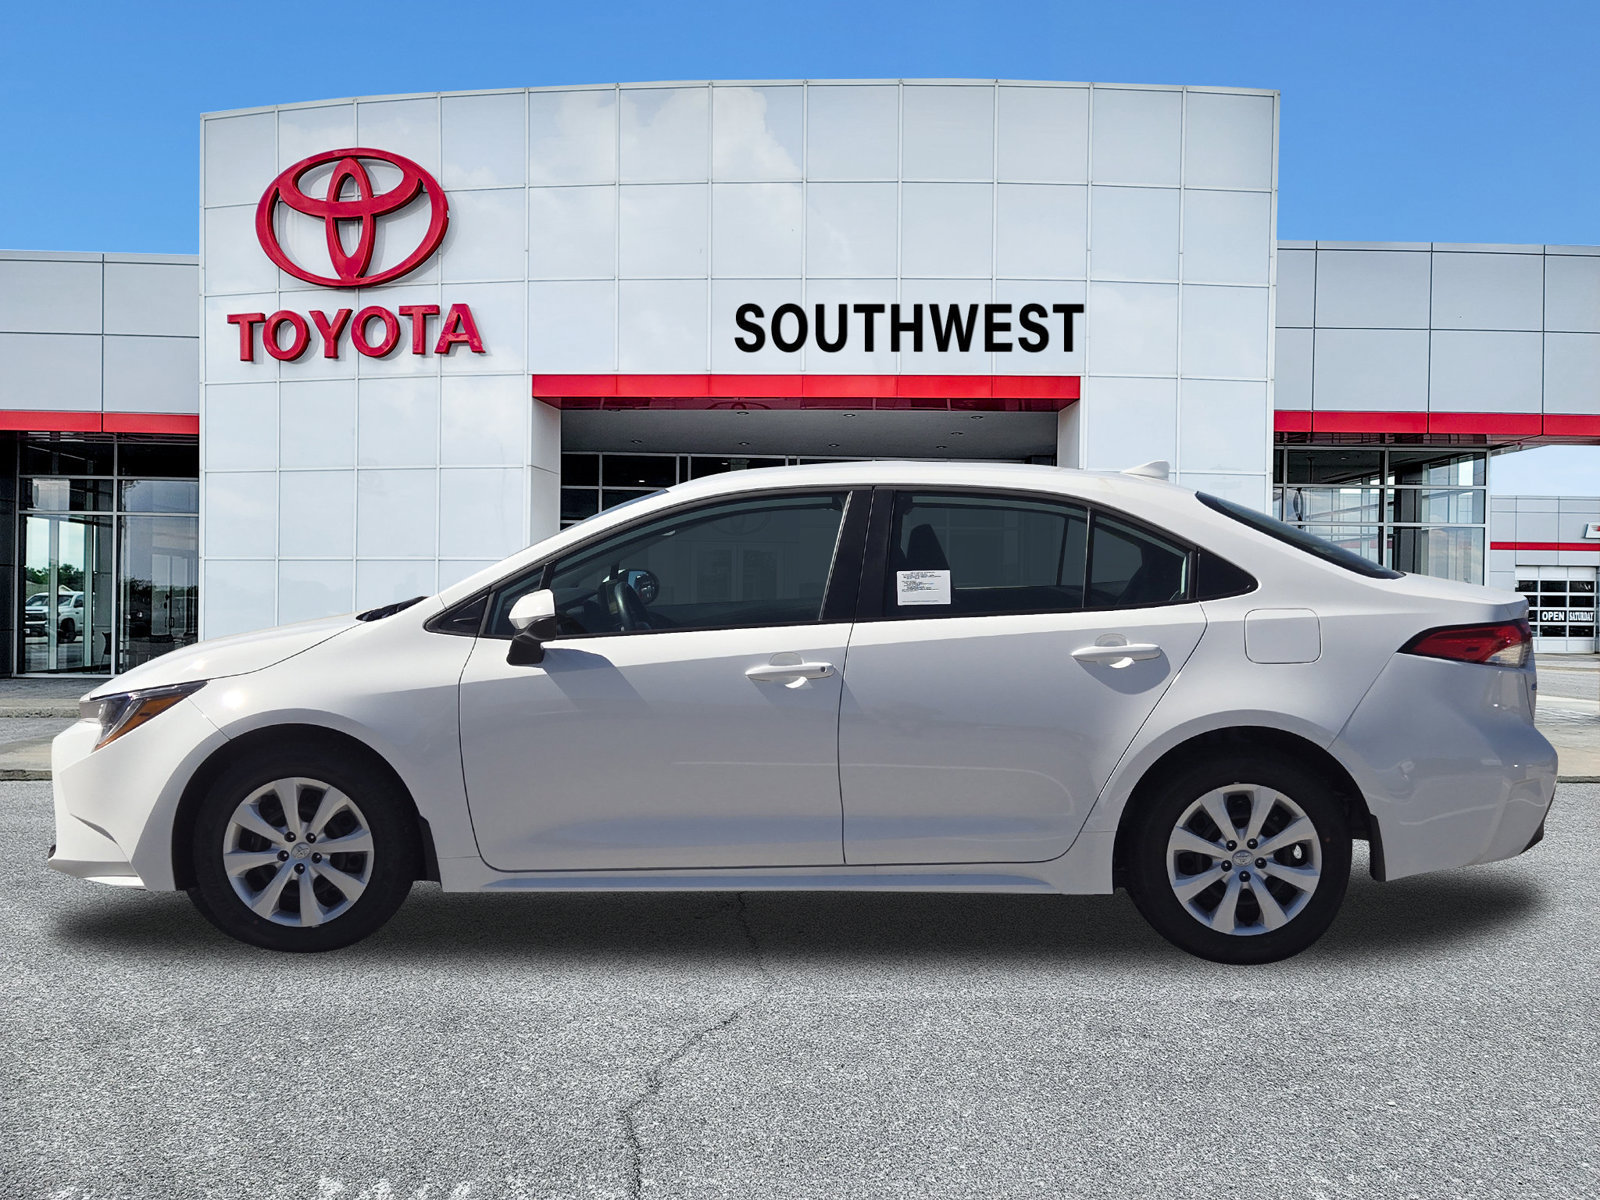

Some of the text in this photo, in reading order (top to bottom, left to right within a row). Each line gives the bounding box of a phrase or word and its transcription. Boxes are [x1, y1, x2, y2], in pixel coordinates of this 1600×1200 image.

[227, 303, 486, 361] TOYOTA
[734, 303, 1084, 353] SOUTHWEST
[1541, 611, 1594, 621] OPEN SATURDAY
